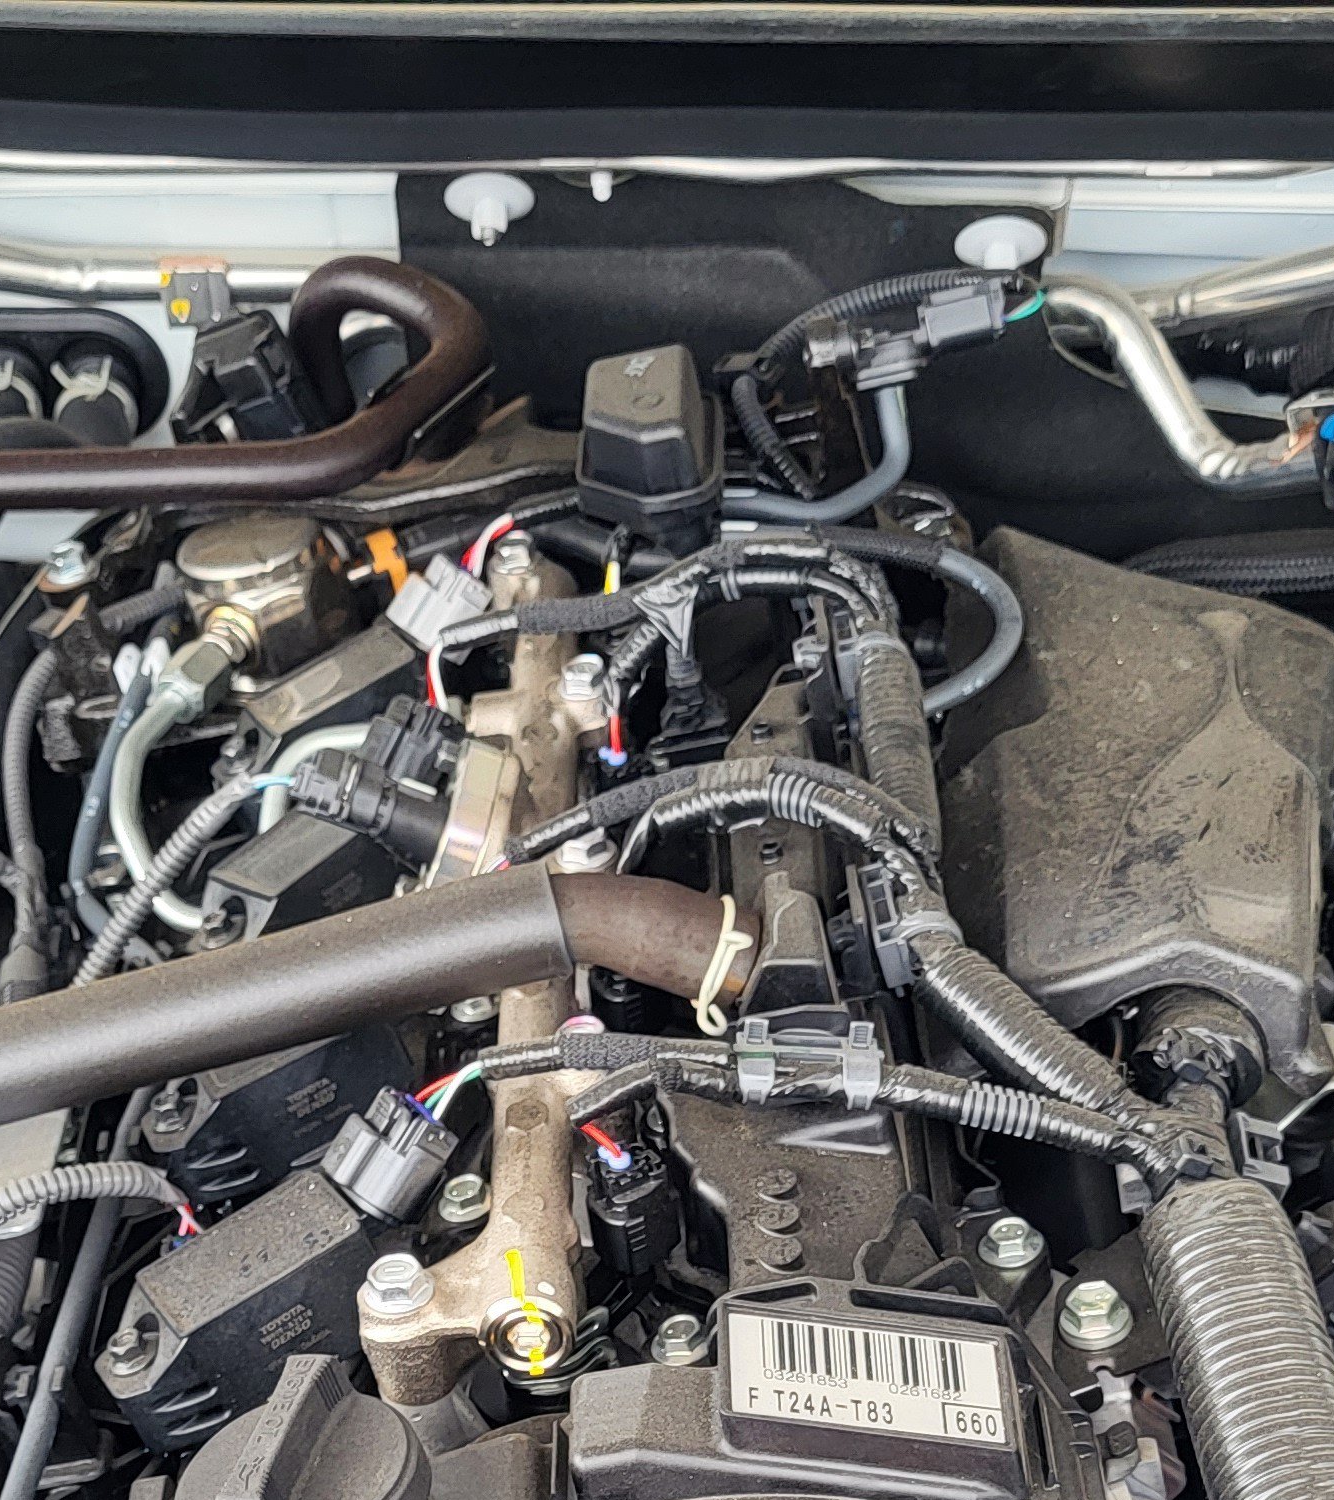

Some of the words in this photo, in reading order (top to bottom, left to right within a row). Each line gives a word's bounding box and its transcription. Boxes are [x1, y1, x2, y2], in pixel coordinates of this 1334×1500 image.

[259, 1304, 306, 1335] TOYOTA
[271, 1318, 312, 1350] DENSO
[763, 1368, 849, 1389] 03261853
[887, 1383, 963, 1401] 0261682
[747, 1386, 760, 1409] F
[773, 1389, 895, 1425] T24A-T83
[955, 1410, 998, 1437] 660
